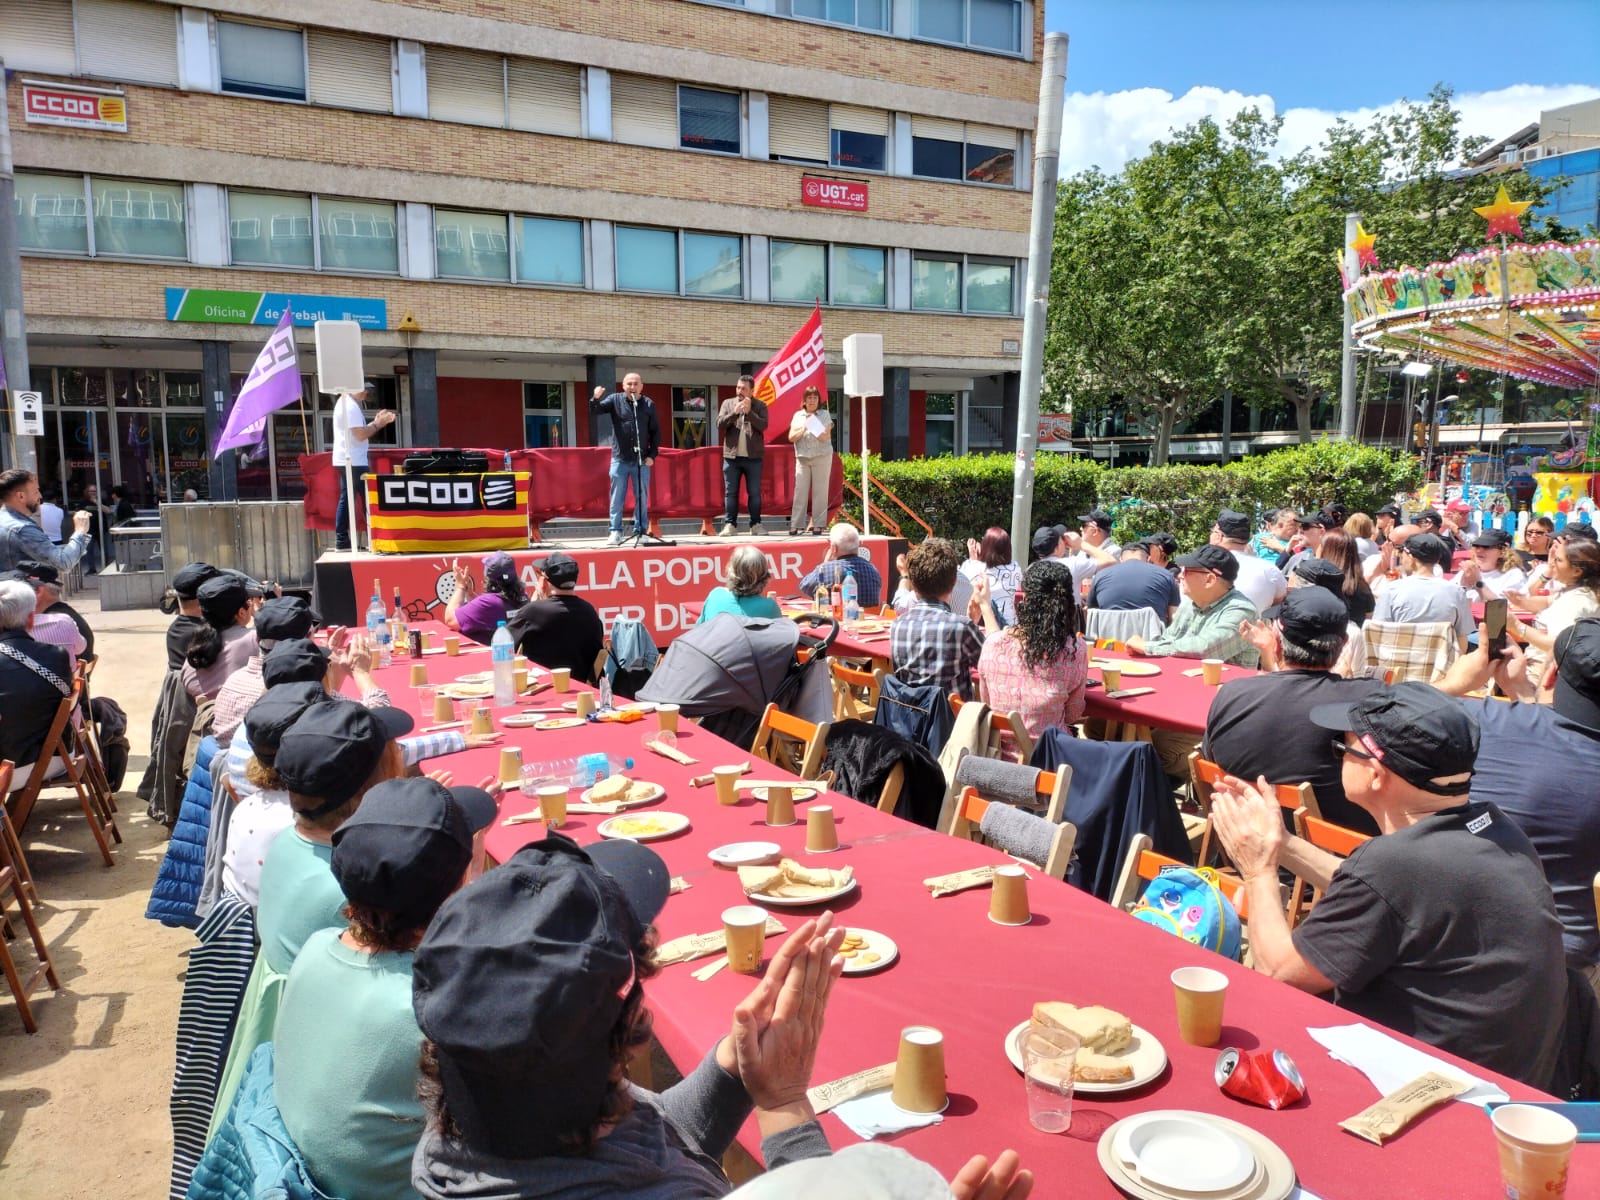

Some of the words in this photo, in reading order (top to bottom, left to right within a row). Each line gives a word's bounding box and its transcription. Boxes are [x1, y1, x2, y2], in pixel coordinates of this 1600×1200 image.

[31, 94, 94, 115] CCOO
[820, 183, 865, 202] UGT.cat
[204, 305, 246, 318] Oficina
[264, 308, 280, 319] de
[282, 308, 326, 321] reball
[384, 481, 474, 504] CCOO
[643, 552, 802, 587] POPUAR
